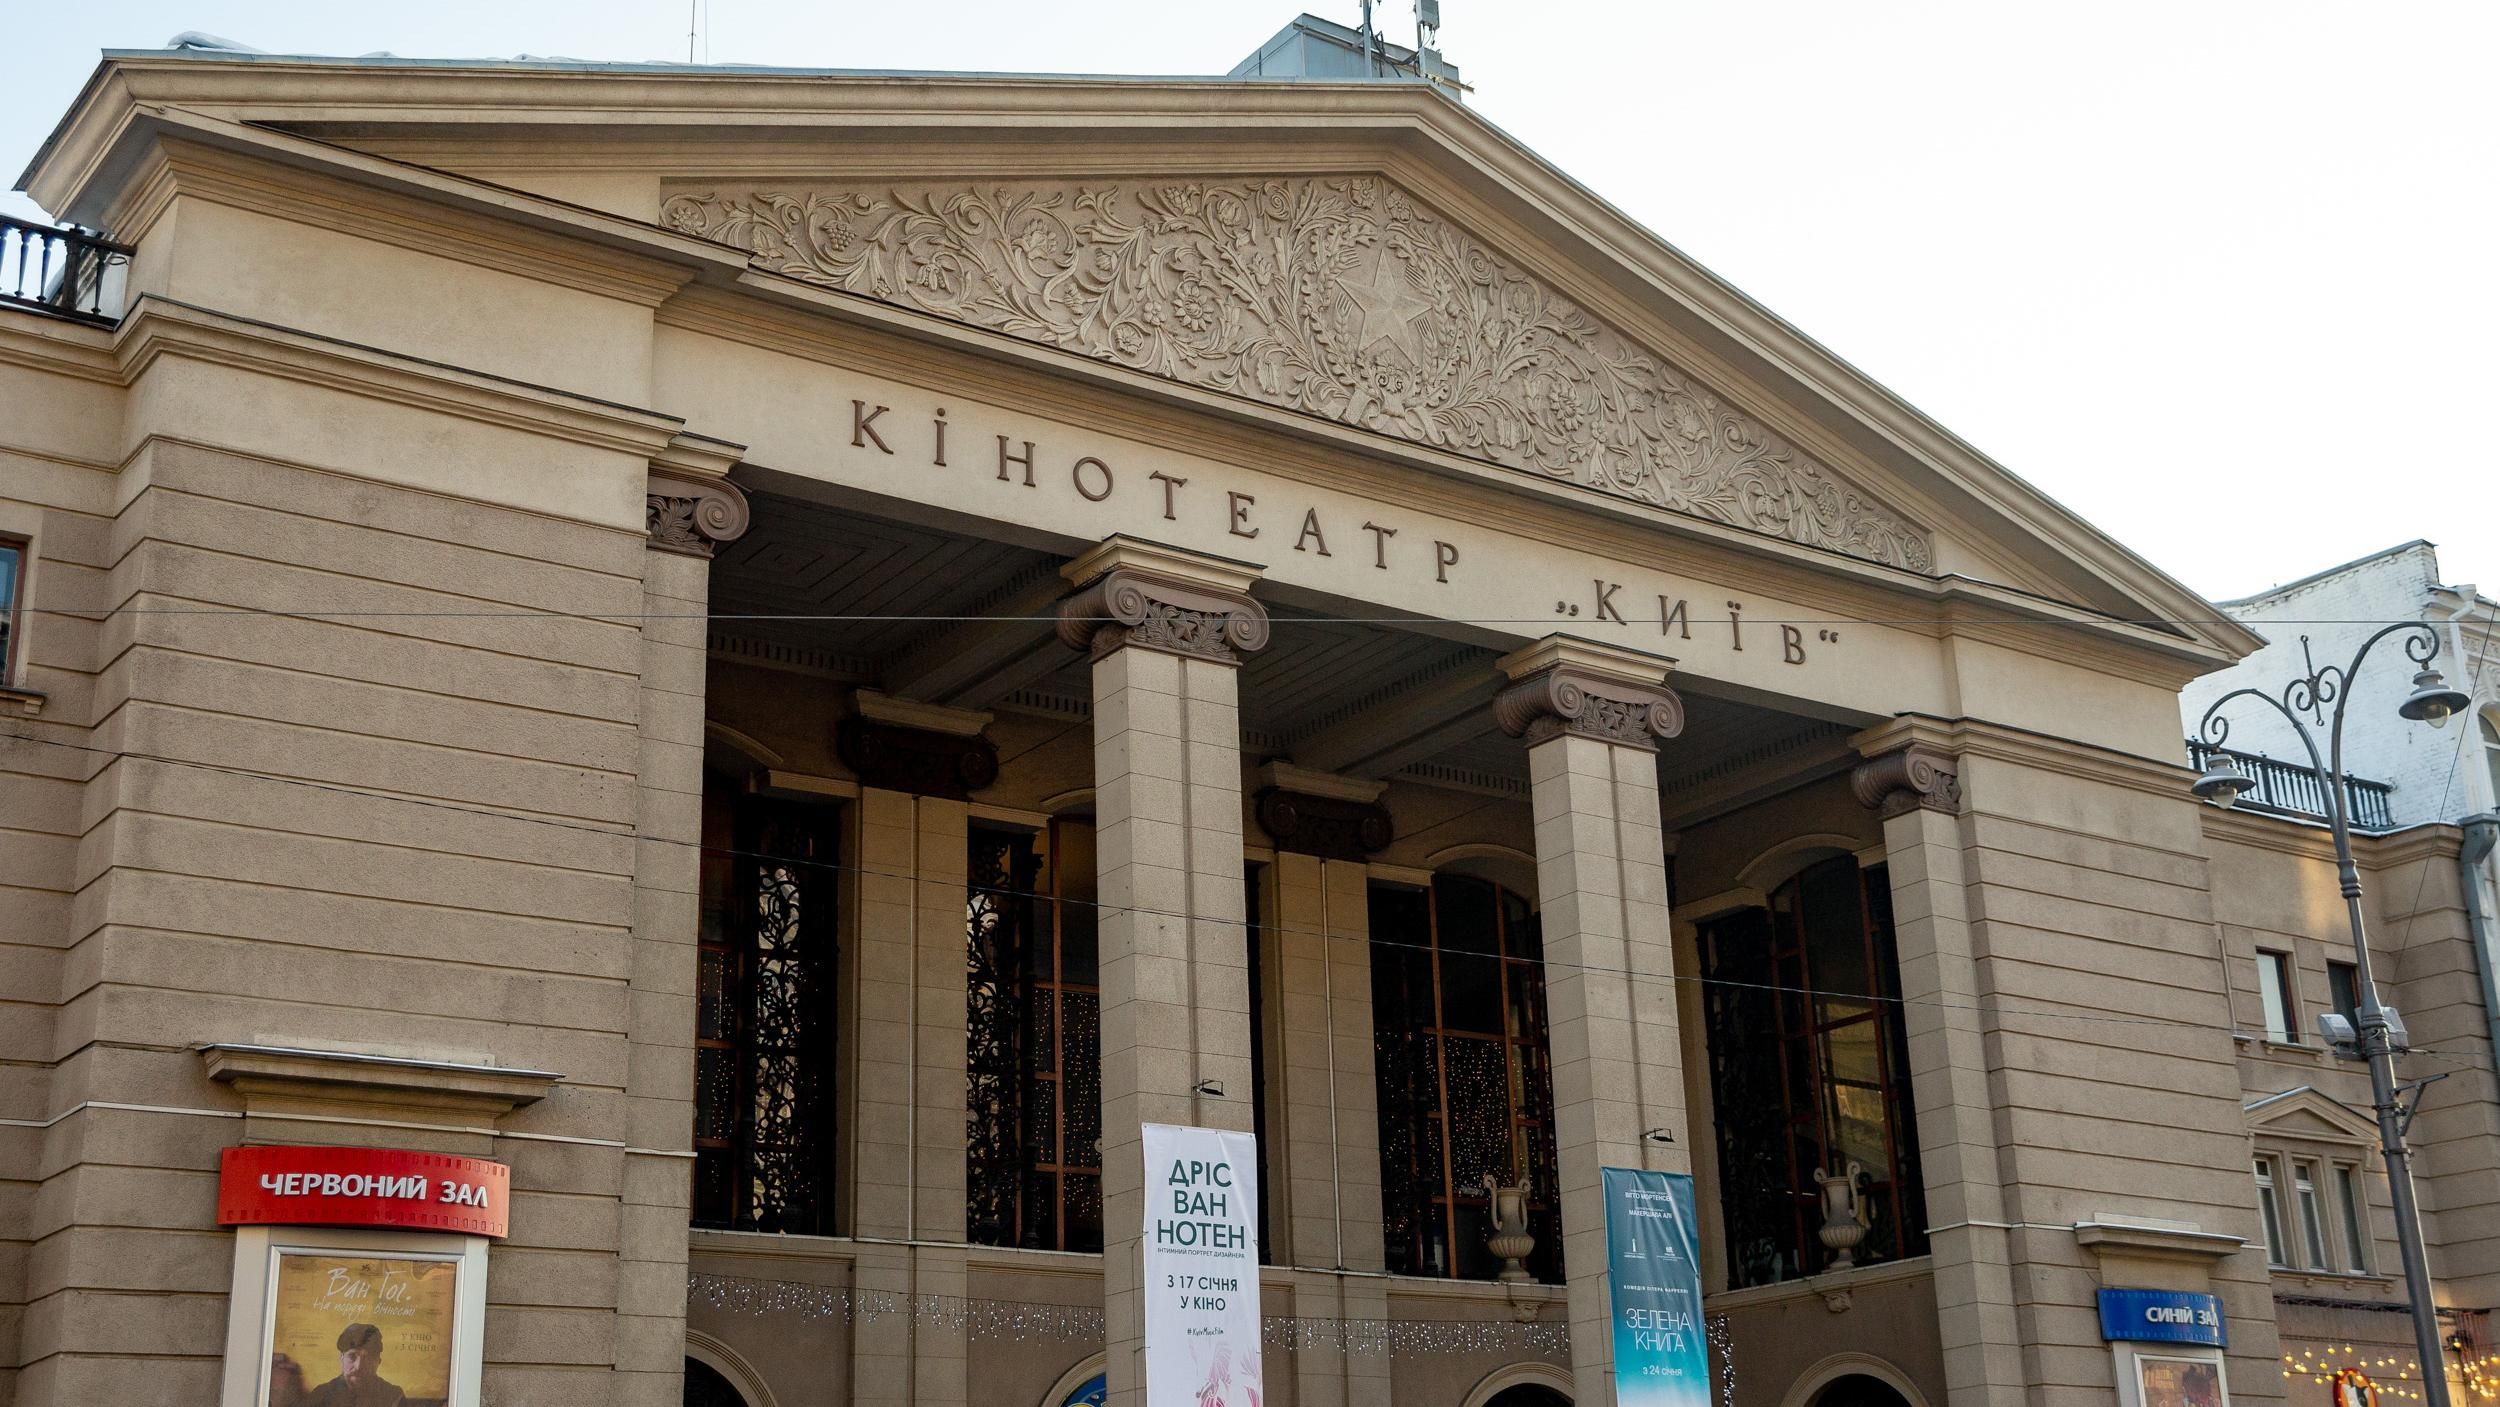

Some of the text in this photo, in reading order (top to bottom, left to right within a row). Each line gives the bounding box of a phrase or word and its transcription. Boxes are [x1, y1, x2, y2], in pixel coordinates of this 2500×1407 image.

[850, 399, 1460, 584] КІНОТЕАТР
[1168, 1159, 1233, 1188] ДРІС
[261, 1173, 488, 1207] ЧЕРВОНИЙ ЗАЛ
[1173, 1189, 1227, 1217] ВАН
[1157, 1219, 1246, 1249] НОТЕН
[1188, 1249, 1213, 1257] ПОРТРЕТ
[1213, 1251, 1245, 1259] ДИЗАЙНЕРА
[327, 1267, 372, 1300] Ван
[1179, 1275, 1194, 1290] 17
[1198, 1276, 1238, 1292] СІЧНЯ
[1180, 1295, 1226, 1311] У КІНО
[1626, 1308, 1692, 1331] ЗЕЛЕНА
[2146, 1307, 2219, 1326] СИНІЙ ЗАЛ
[1635, 1331, 1686, 1353] КНИГА
[1649, 1365, 1660, 1376] 24
